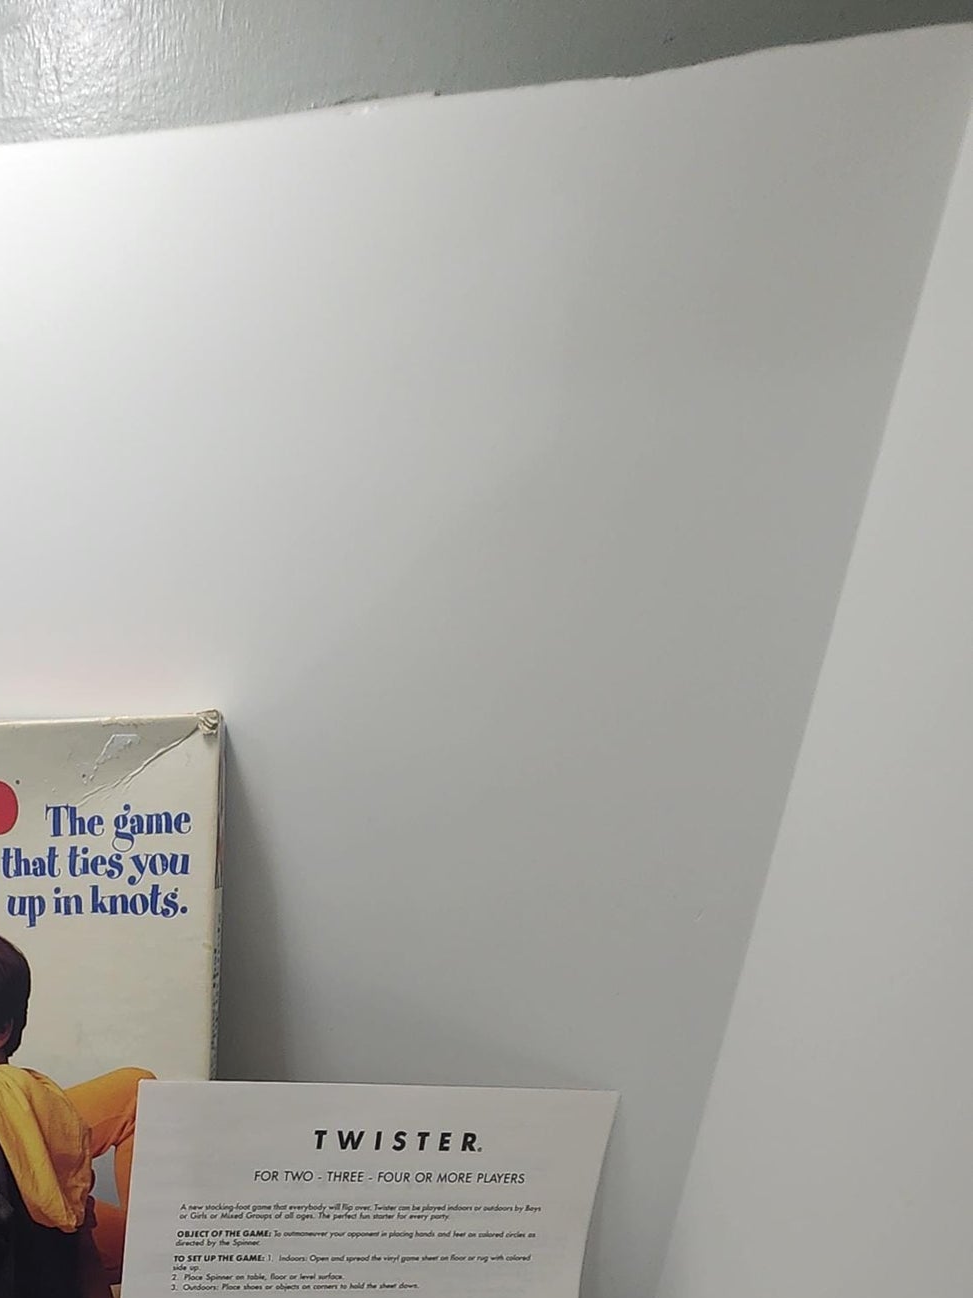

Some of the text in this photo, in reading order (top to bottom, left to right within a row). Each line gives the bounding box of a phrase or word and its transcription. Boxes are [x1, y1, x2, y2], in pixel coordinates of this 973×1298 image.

[45, 803, 192, 853] The game
[2, 846, 190, 885] that ties you
[7, 884, 188, 929] up in knots.
[254, 1170, 278, 1182] FOR
[285, 1170, 313, 1182] TWO
[328, 1171, 364, 1182] THREE
[377, 1171, 410, 1183] FOUR
[415, 1171, 432, 1183] OR
[437, 1171, 472, 1183] MORE
[477, 1172, 525, 1184] PLAYERS
[205, 1203, 250, 1212] stocking-foot
[289, 1204, 326, 1213] everybody
[341, 1204, 354, 1213] flip
[421, 1204, 446, 1213] played
[483, 1204, 513, 1212] outdoors
[514, 1204, 523, 1213] by
[525, 1204, 542, 1213] Boys
[245, 1212, 272, 1221] Groups
[333, 1212, 357, 1221] perfect
[430, 1212, 451, 1221] party.
[207, 1239, 216, 1248] by
[233, 1239, 262, 1248] Spinner.
